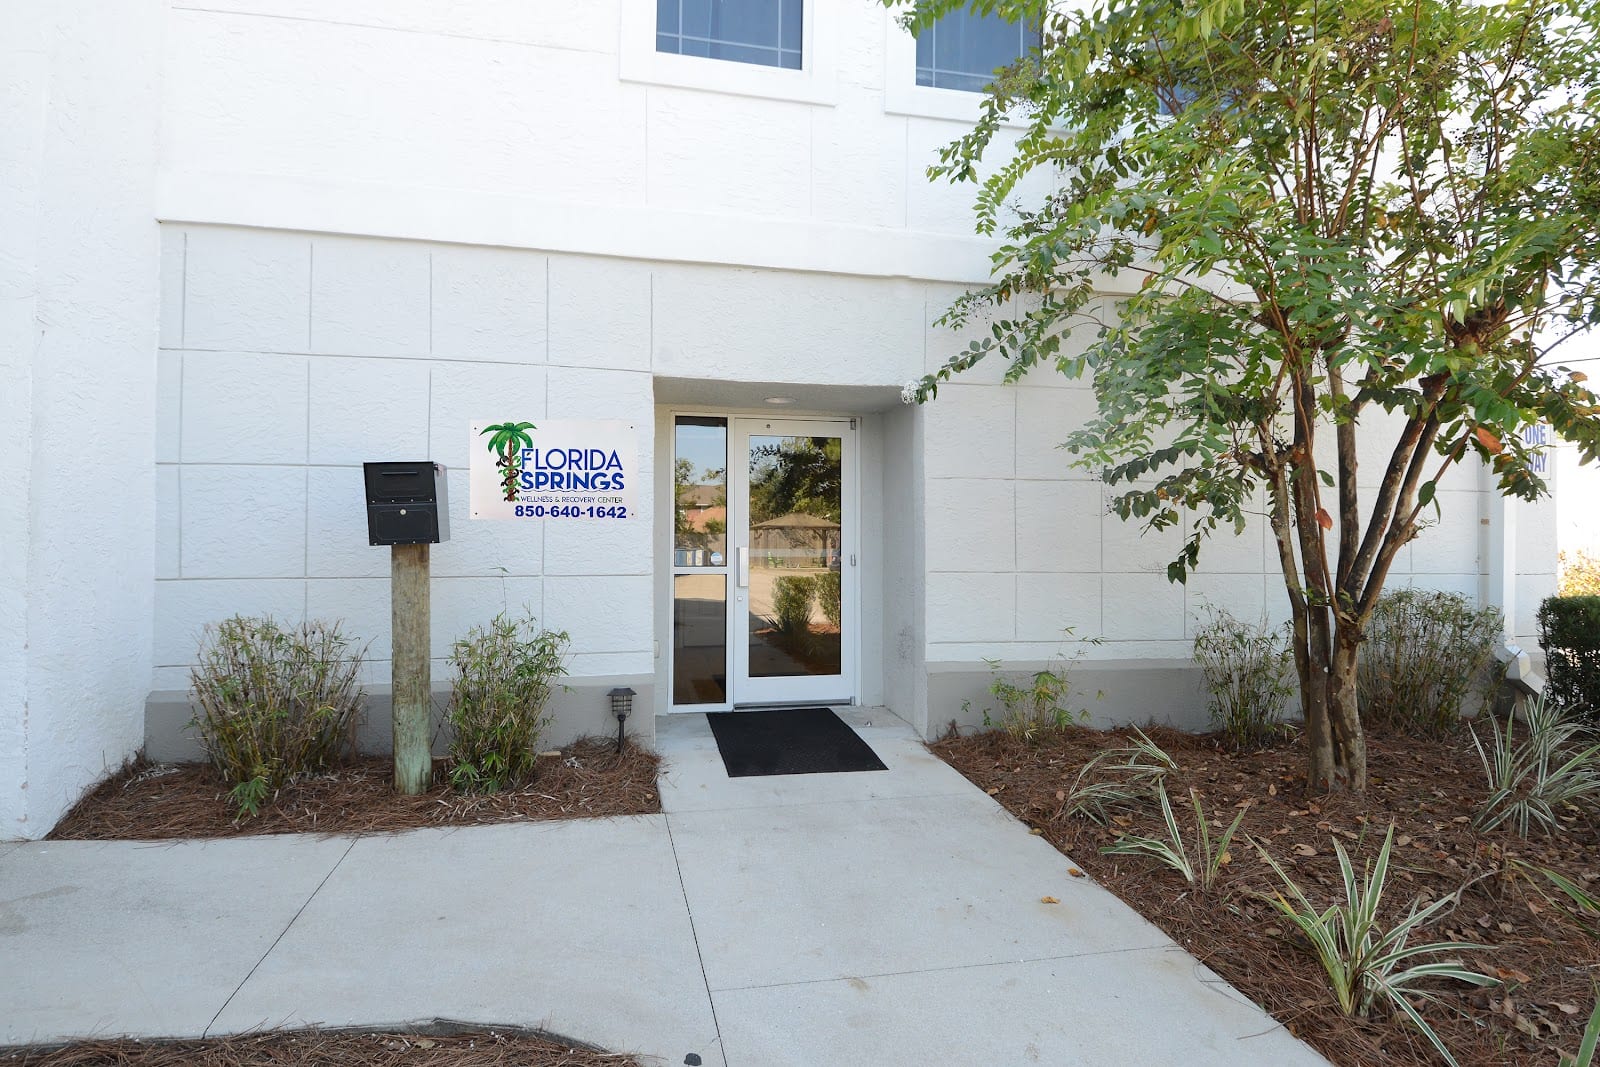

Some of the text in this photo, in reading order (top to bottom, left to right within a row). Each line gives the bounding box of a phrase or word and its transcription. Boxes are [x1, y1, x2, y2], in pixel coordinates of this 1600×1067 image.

[1525, 424, 1546, 445] ONE
[521, 448, 623, 470] FLORIDA
[521, 472, 625, 490] SPRINGS
[515, 505, 627, 519] 850-640-1642
